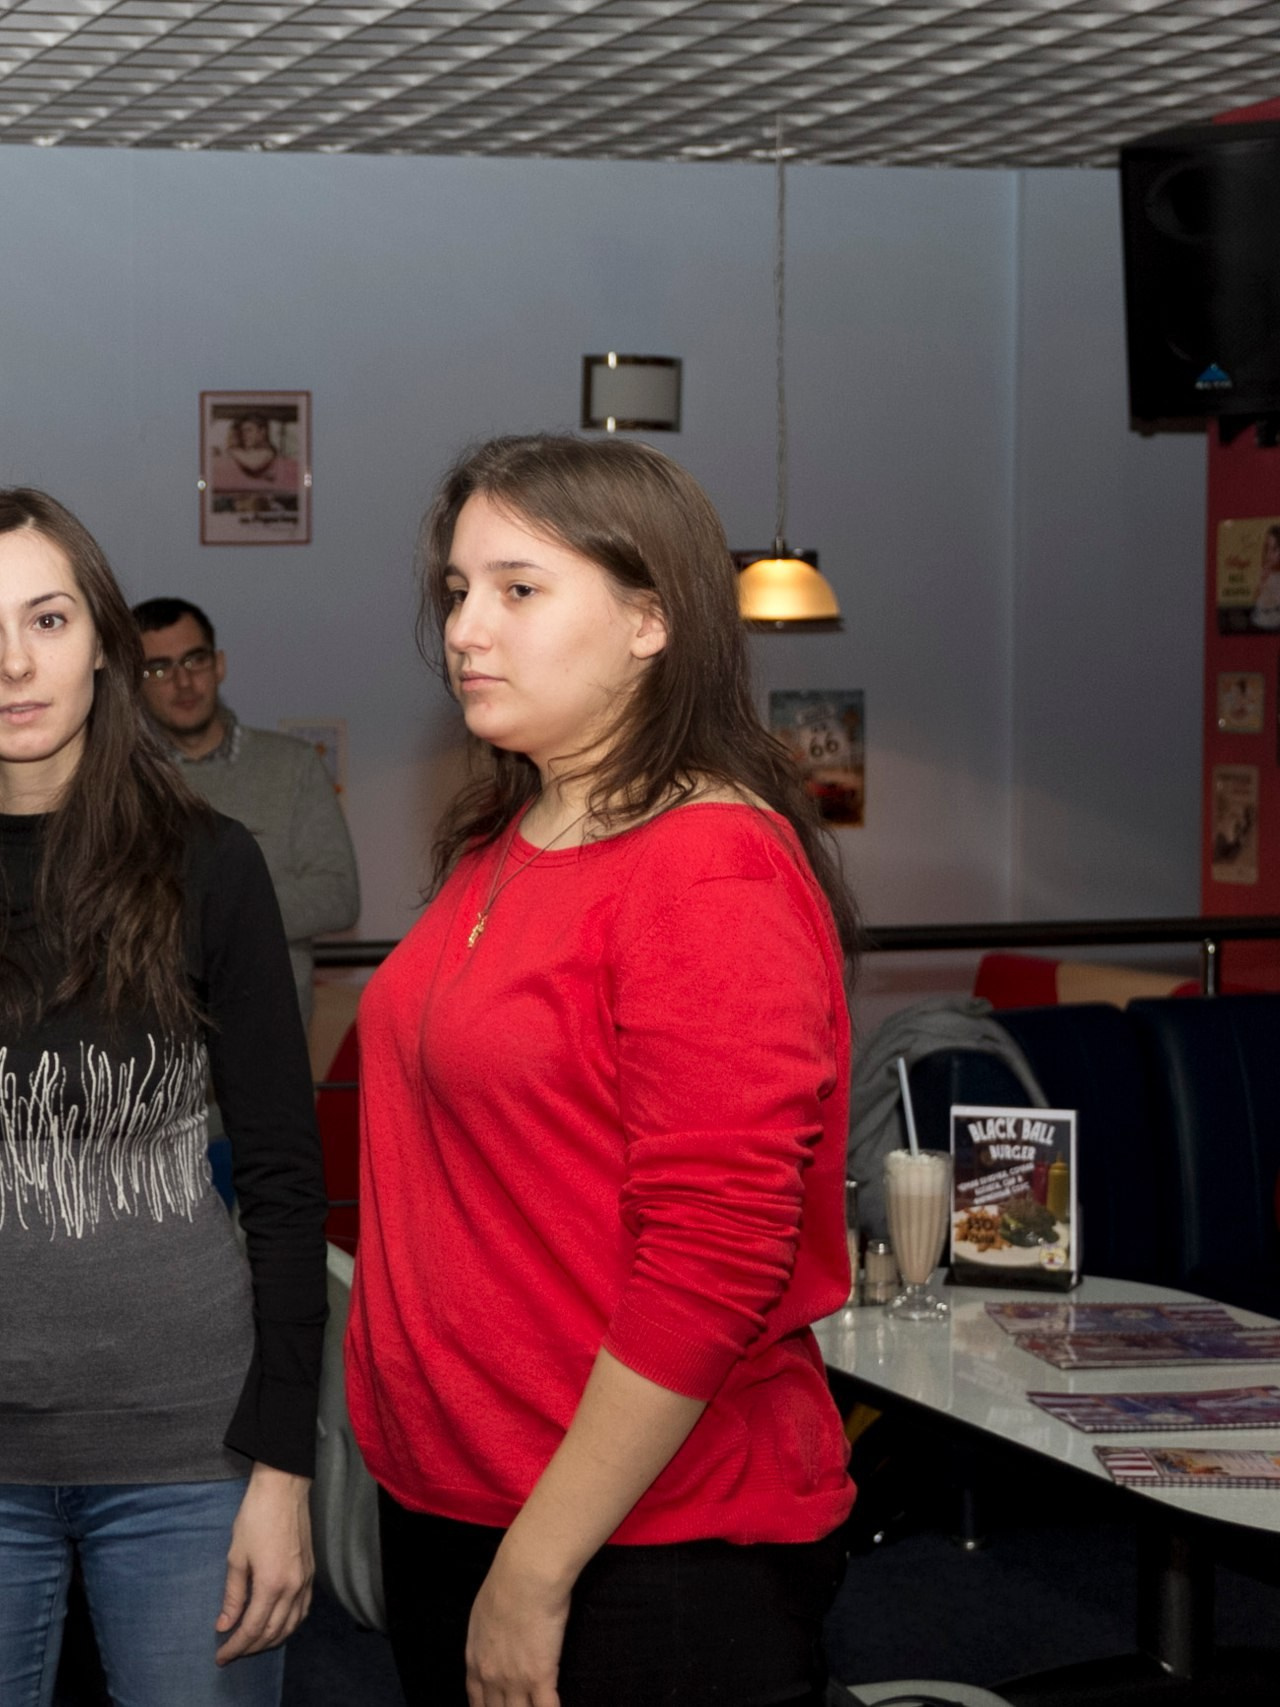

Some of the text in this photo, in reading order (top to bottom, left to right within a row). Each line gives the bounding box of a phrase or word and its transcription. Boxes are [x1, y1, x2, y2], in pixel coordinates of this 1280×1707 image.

[968, 1117, 1055, 1146] BLACK BALL
[989, 1144, 1036, 1161] BURGER
